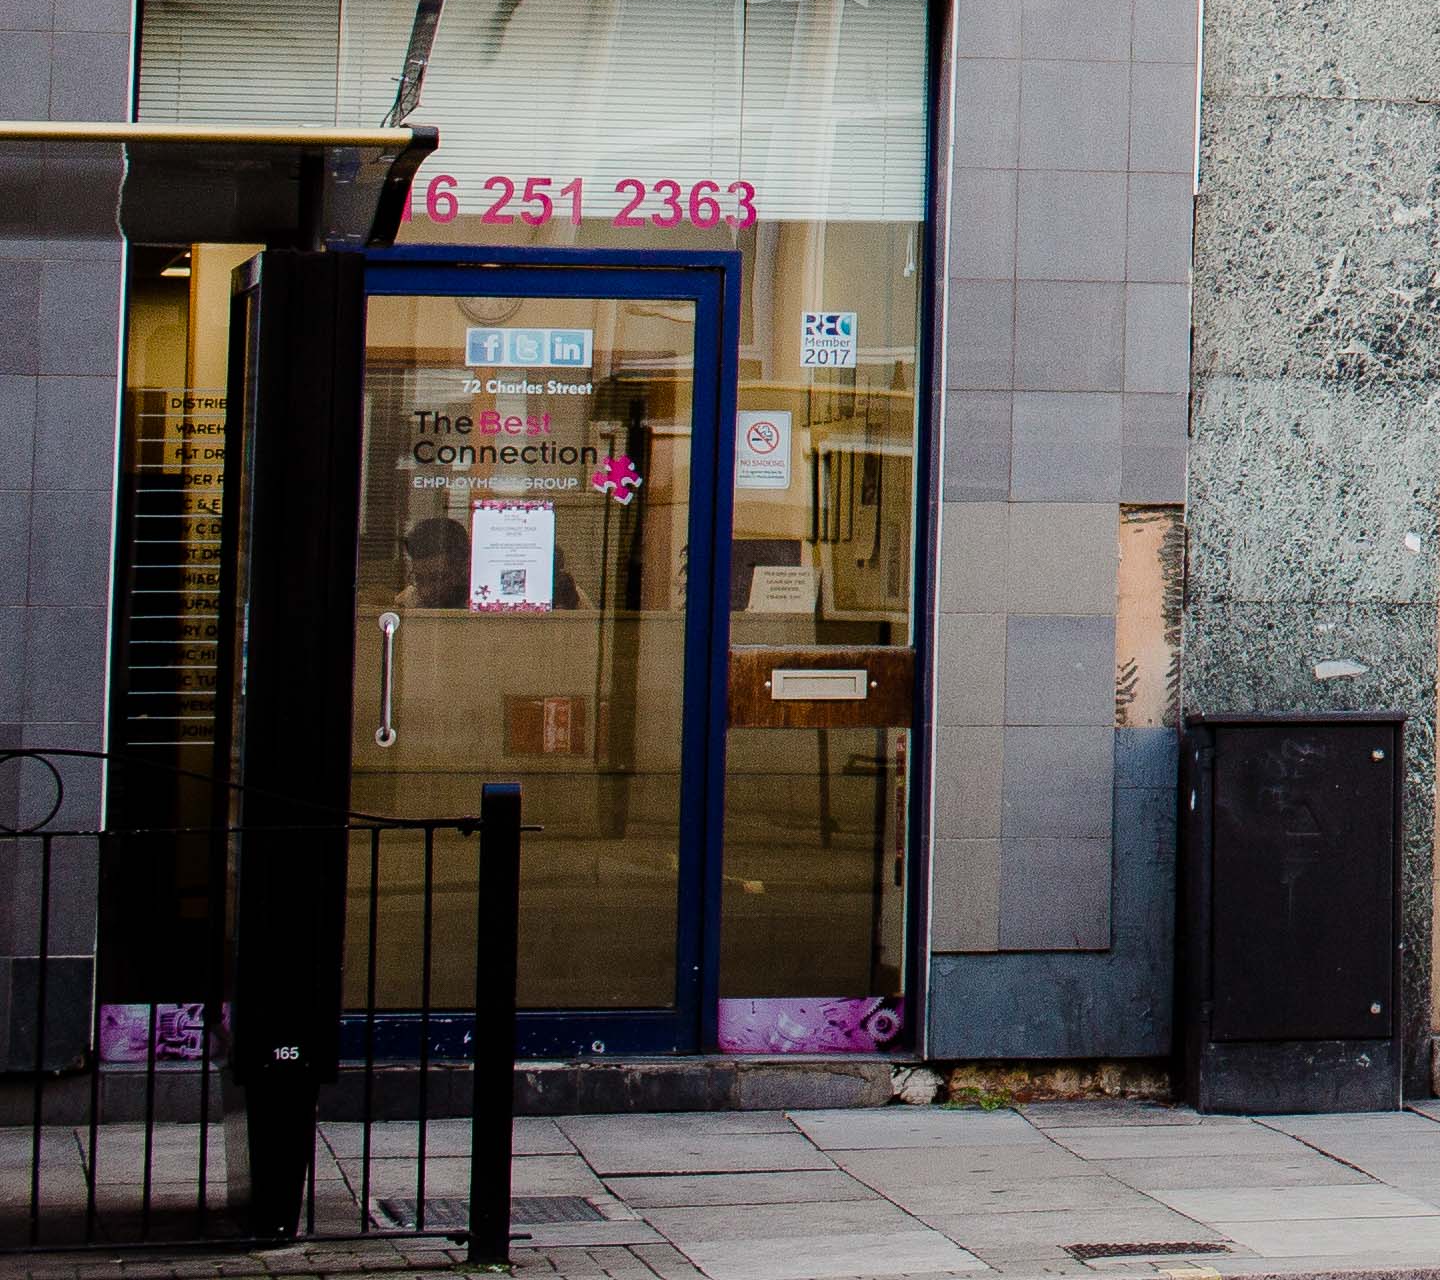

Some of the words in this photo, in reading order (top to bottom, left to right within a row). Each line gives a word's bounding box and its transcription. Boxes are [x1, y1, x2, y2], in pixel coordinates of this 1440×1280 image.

[480, 176, 583, 226] 251
[612, 179, 757, 230] 2363
[805, 338, 850, 347] Member
[805, 349, 850, 365] 2017
[462, 380, 481, 393] 72
[486, 380, 542, 394] Charles
[548, 380, 592, 395] Street
[415, 411, 473, 434] The
[479, 410, 551, 435] Best
[413, 441, 597, 464] Connection
[752, 460, 785, 468] SMOKING
[524, 477, 578, 489] GROUP
[273, 1046, 299, 1060] 165
